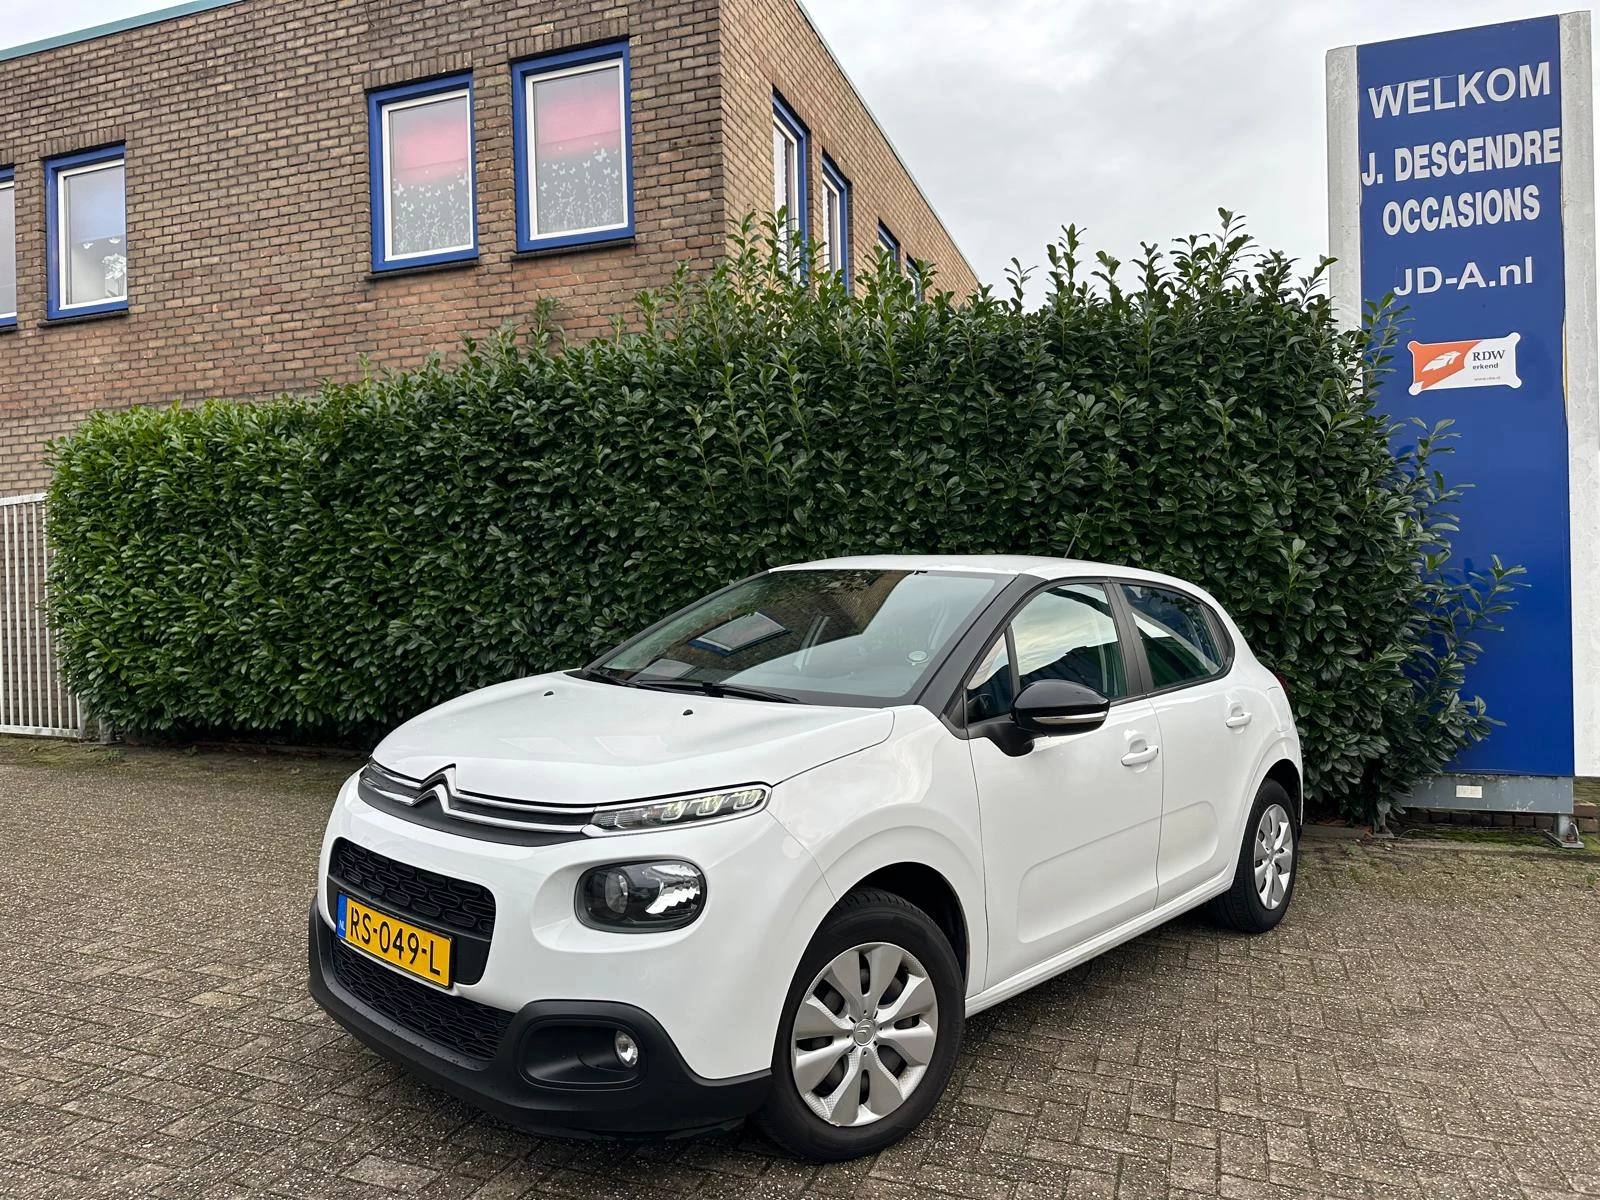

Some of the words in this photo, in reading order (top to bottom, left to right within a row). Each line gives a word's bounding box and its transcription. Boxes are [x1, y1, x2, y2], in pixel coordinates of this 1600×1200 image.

[1368, 62, 1550, 118] WELKOM
[1361, 153, 1384, 186] J.
[1395, 128, 1561, 182] DESCENDRE
[1382, 184, 1541, 236] OCCASIONS
[1393, 256, 1533, 296] JD-A.nl
[1472, 349, 1506, 361] RDW
[1472, 362, 1499, 370] erkend
[339, 919, 346, 931] NL
[350, 906, 441, 977] RS-049-L
